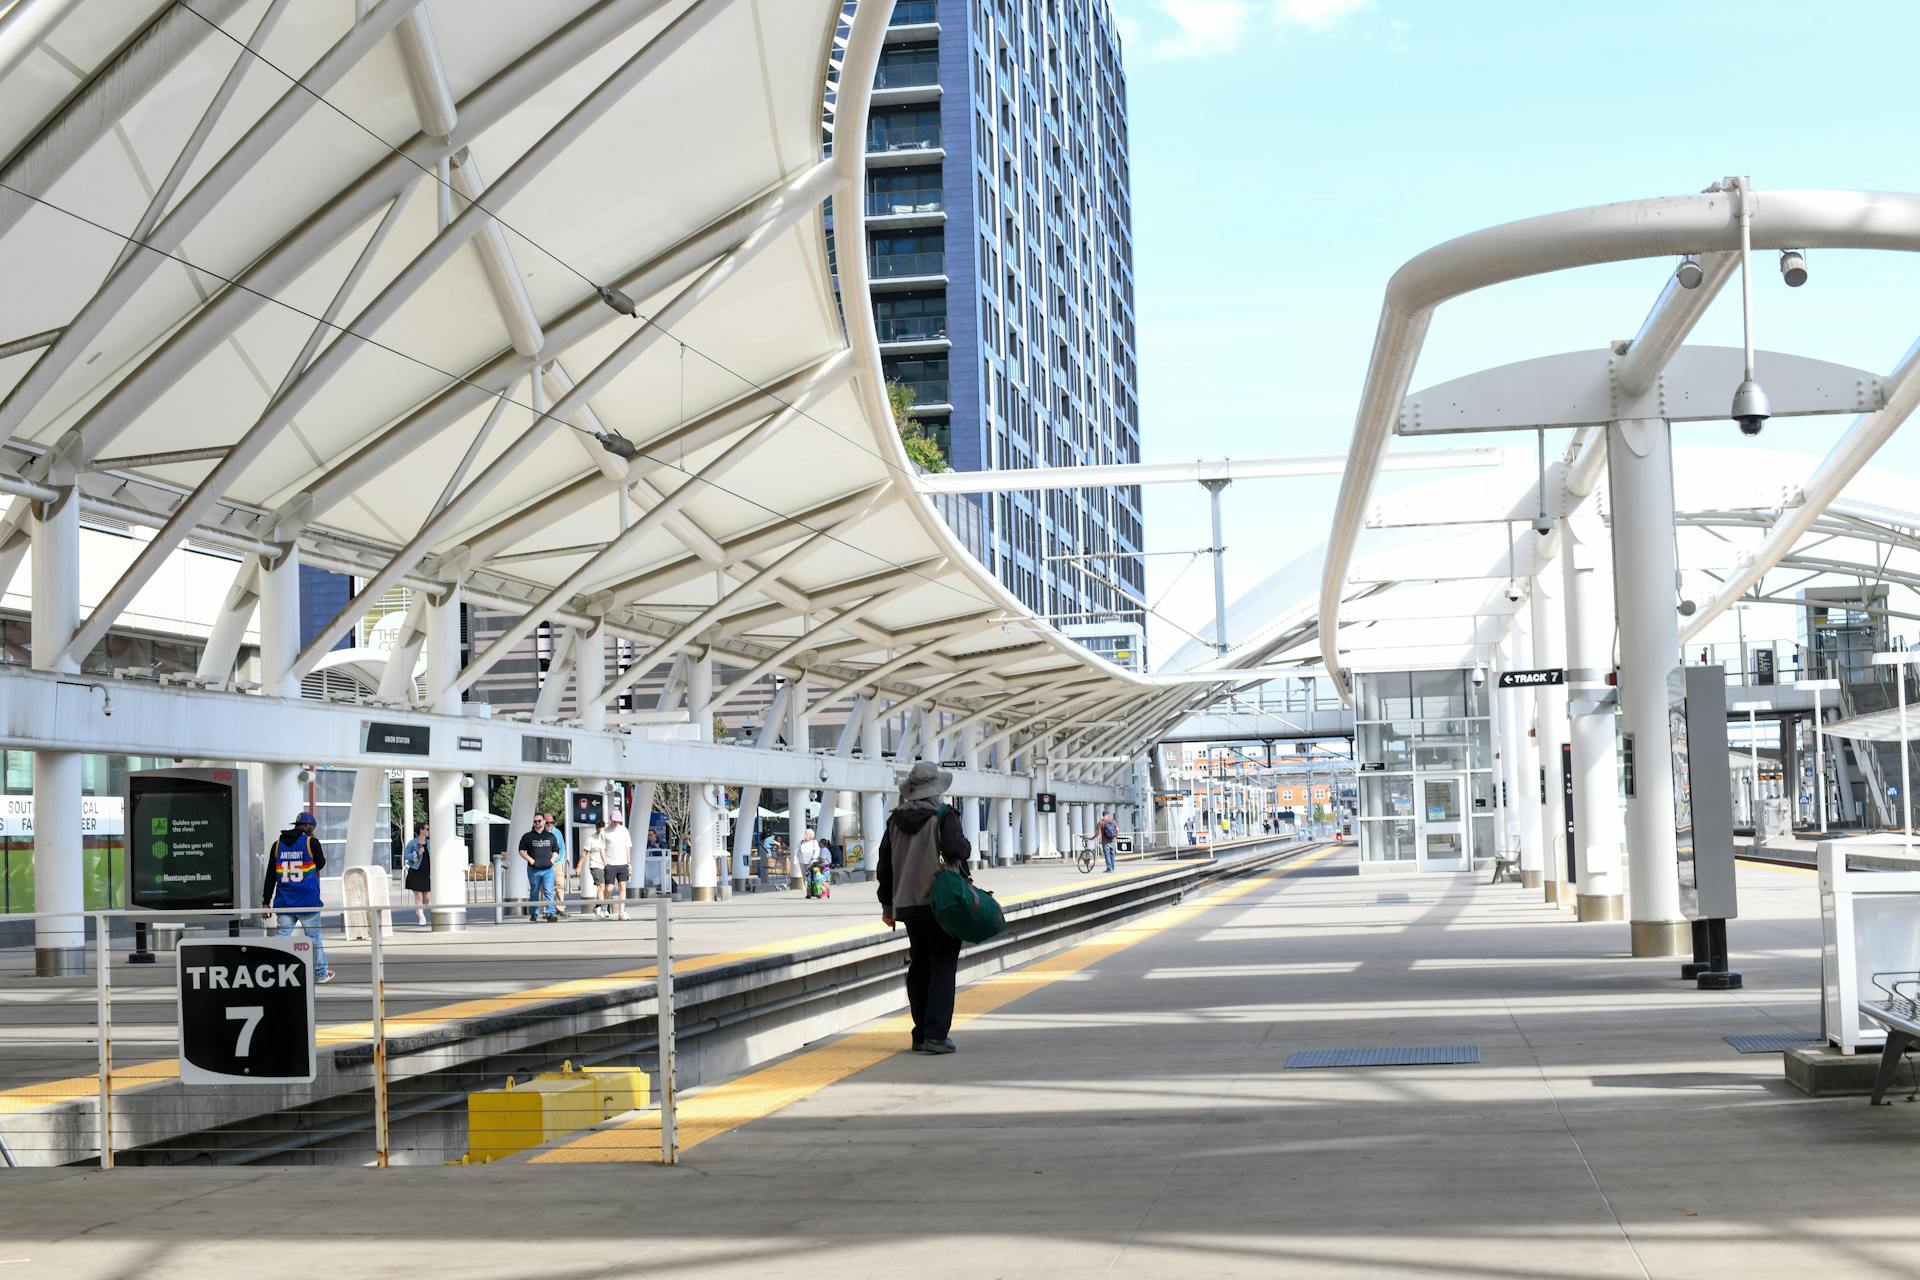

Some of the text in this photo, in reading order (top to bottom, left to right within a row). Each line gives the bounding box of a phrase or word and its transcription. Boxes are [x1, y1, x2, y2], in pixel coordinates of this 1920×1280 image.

[1514, 671, 1559, 683] TRACK 7
[384, 735, 411, 744] UNION STATION
[8, 801, 32, 814] SOUT
[191, 820, 200, 828] you
[1121, 843, 1127, 851] 8
[280, 851, 303, 860] ANTHONY
[281, 861, 304, 883] 15
[163, 873, 212, 883] Huntington Bank
[294, 943, 310, 951] RTD
[186, 963, 301, 990] TRACK
[225, 1006, 264, 1057] 7
